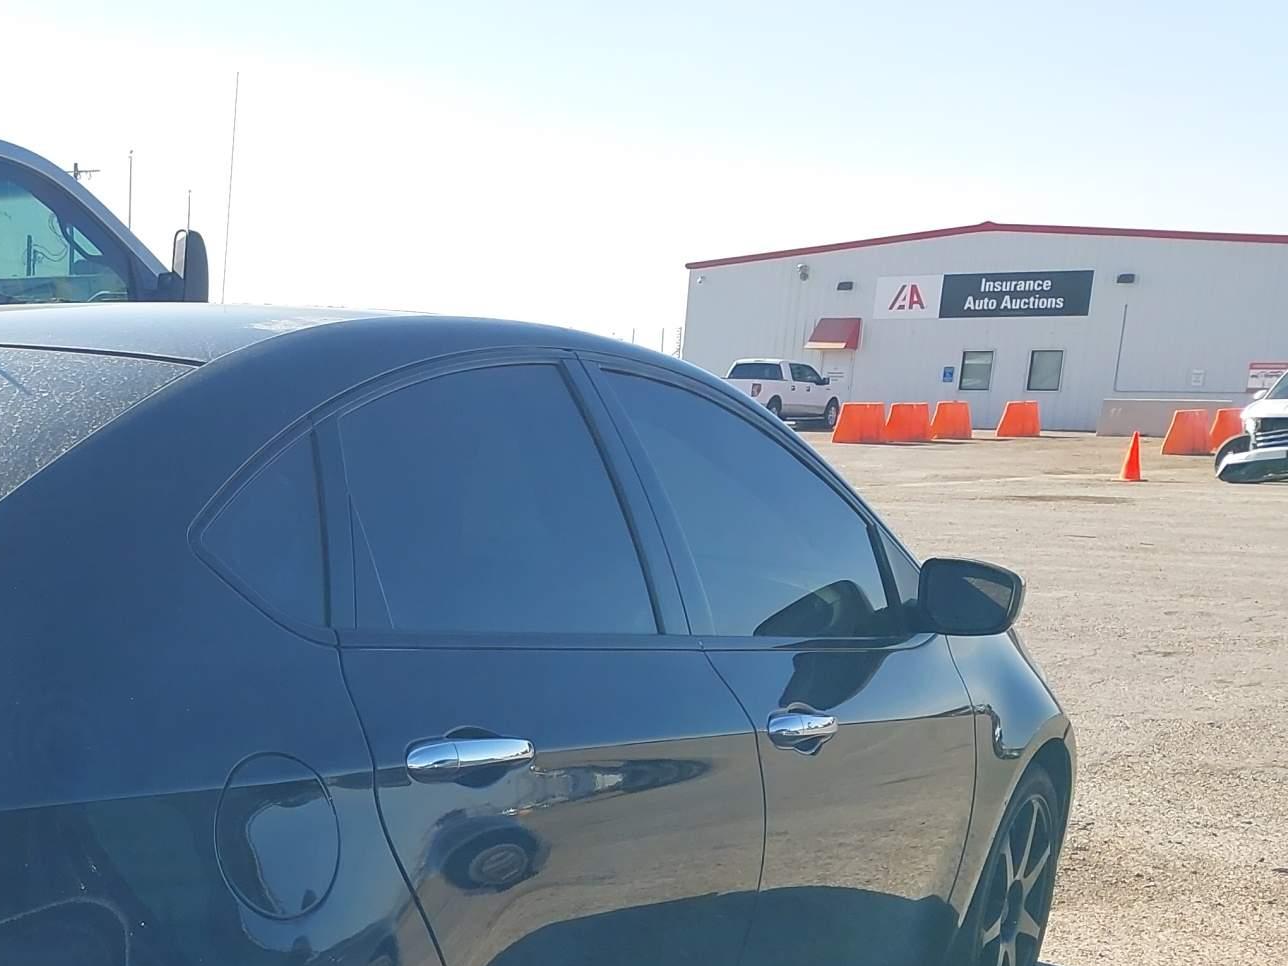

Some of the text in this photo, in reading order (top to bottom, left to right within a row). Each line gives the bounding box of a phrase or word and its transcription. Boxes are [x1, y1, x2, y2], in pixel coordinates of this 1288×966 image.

[980, 277, 1052, 293] Insurance
[963, 294, 1065, 311] Auto Auctions
